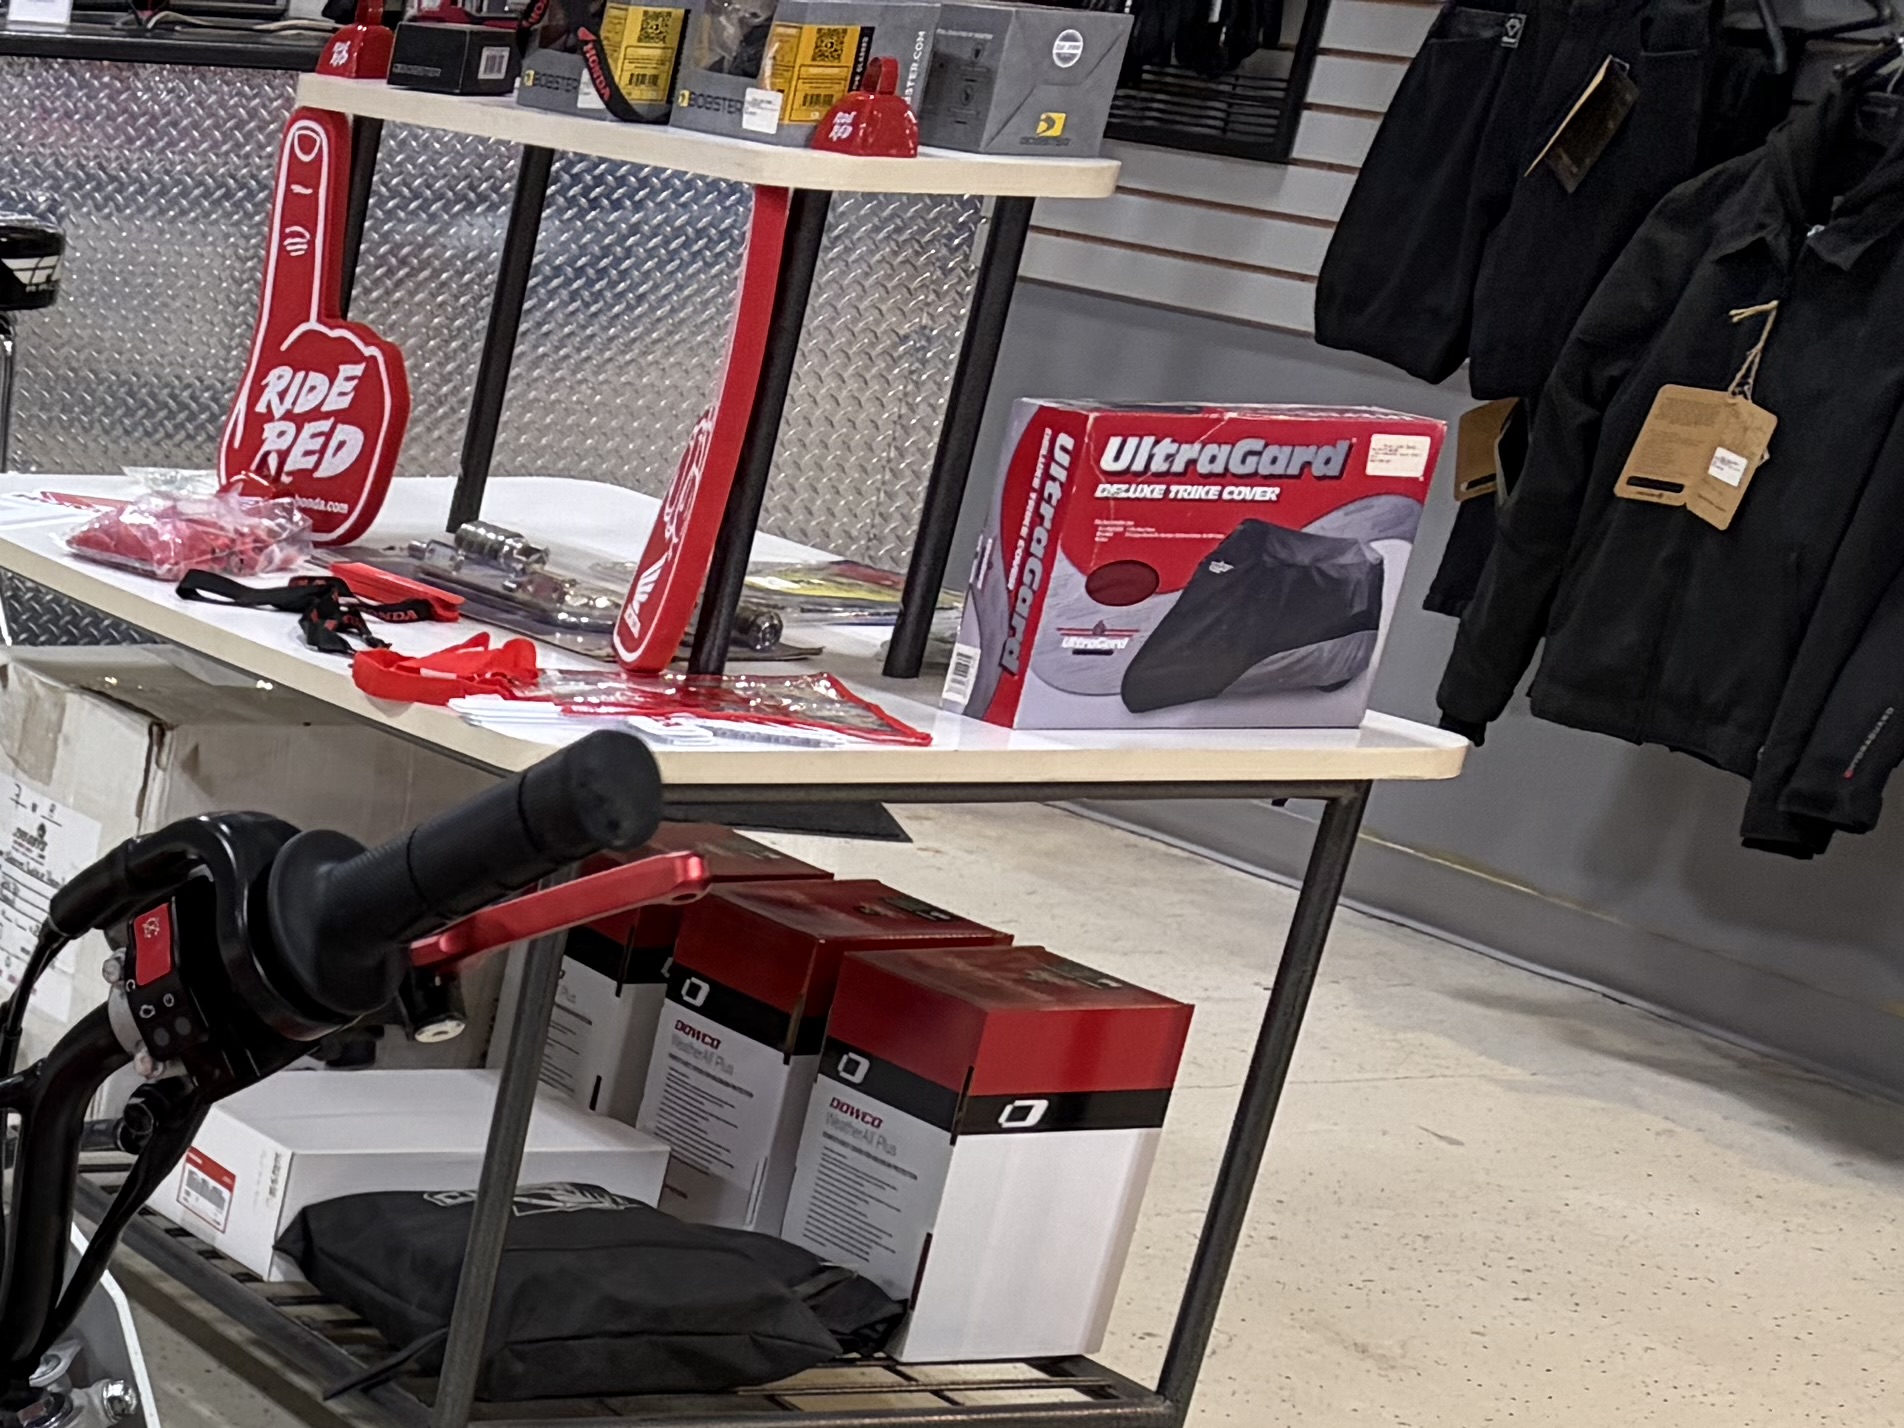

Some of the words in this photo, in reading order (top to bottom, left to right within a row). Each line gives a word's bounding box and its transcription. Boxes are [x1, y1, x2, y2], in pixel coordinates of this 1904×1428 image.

[583, 44, 611, 101] HONDA
[255, 362, 366, 420] RIDE
[250, 416, 365, 484] RED
[1100, 434, 1352, 479] UltraGard
[1094, 483, 1166, 499] DELUXE
[1168, 485, 1222, 500] TRIKE
[1222, 485, 1281, 502] COVER
[1000, 431, 1075, 677] UltraGard
[674, 1019, 722, 1050] DOWCO
[829, 1096, 884, 1129] DOWCO
